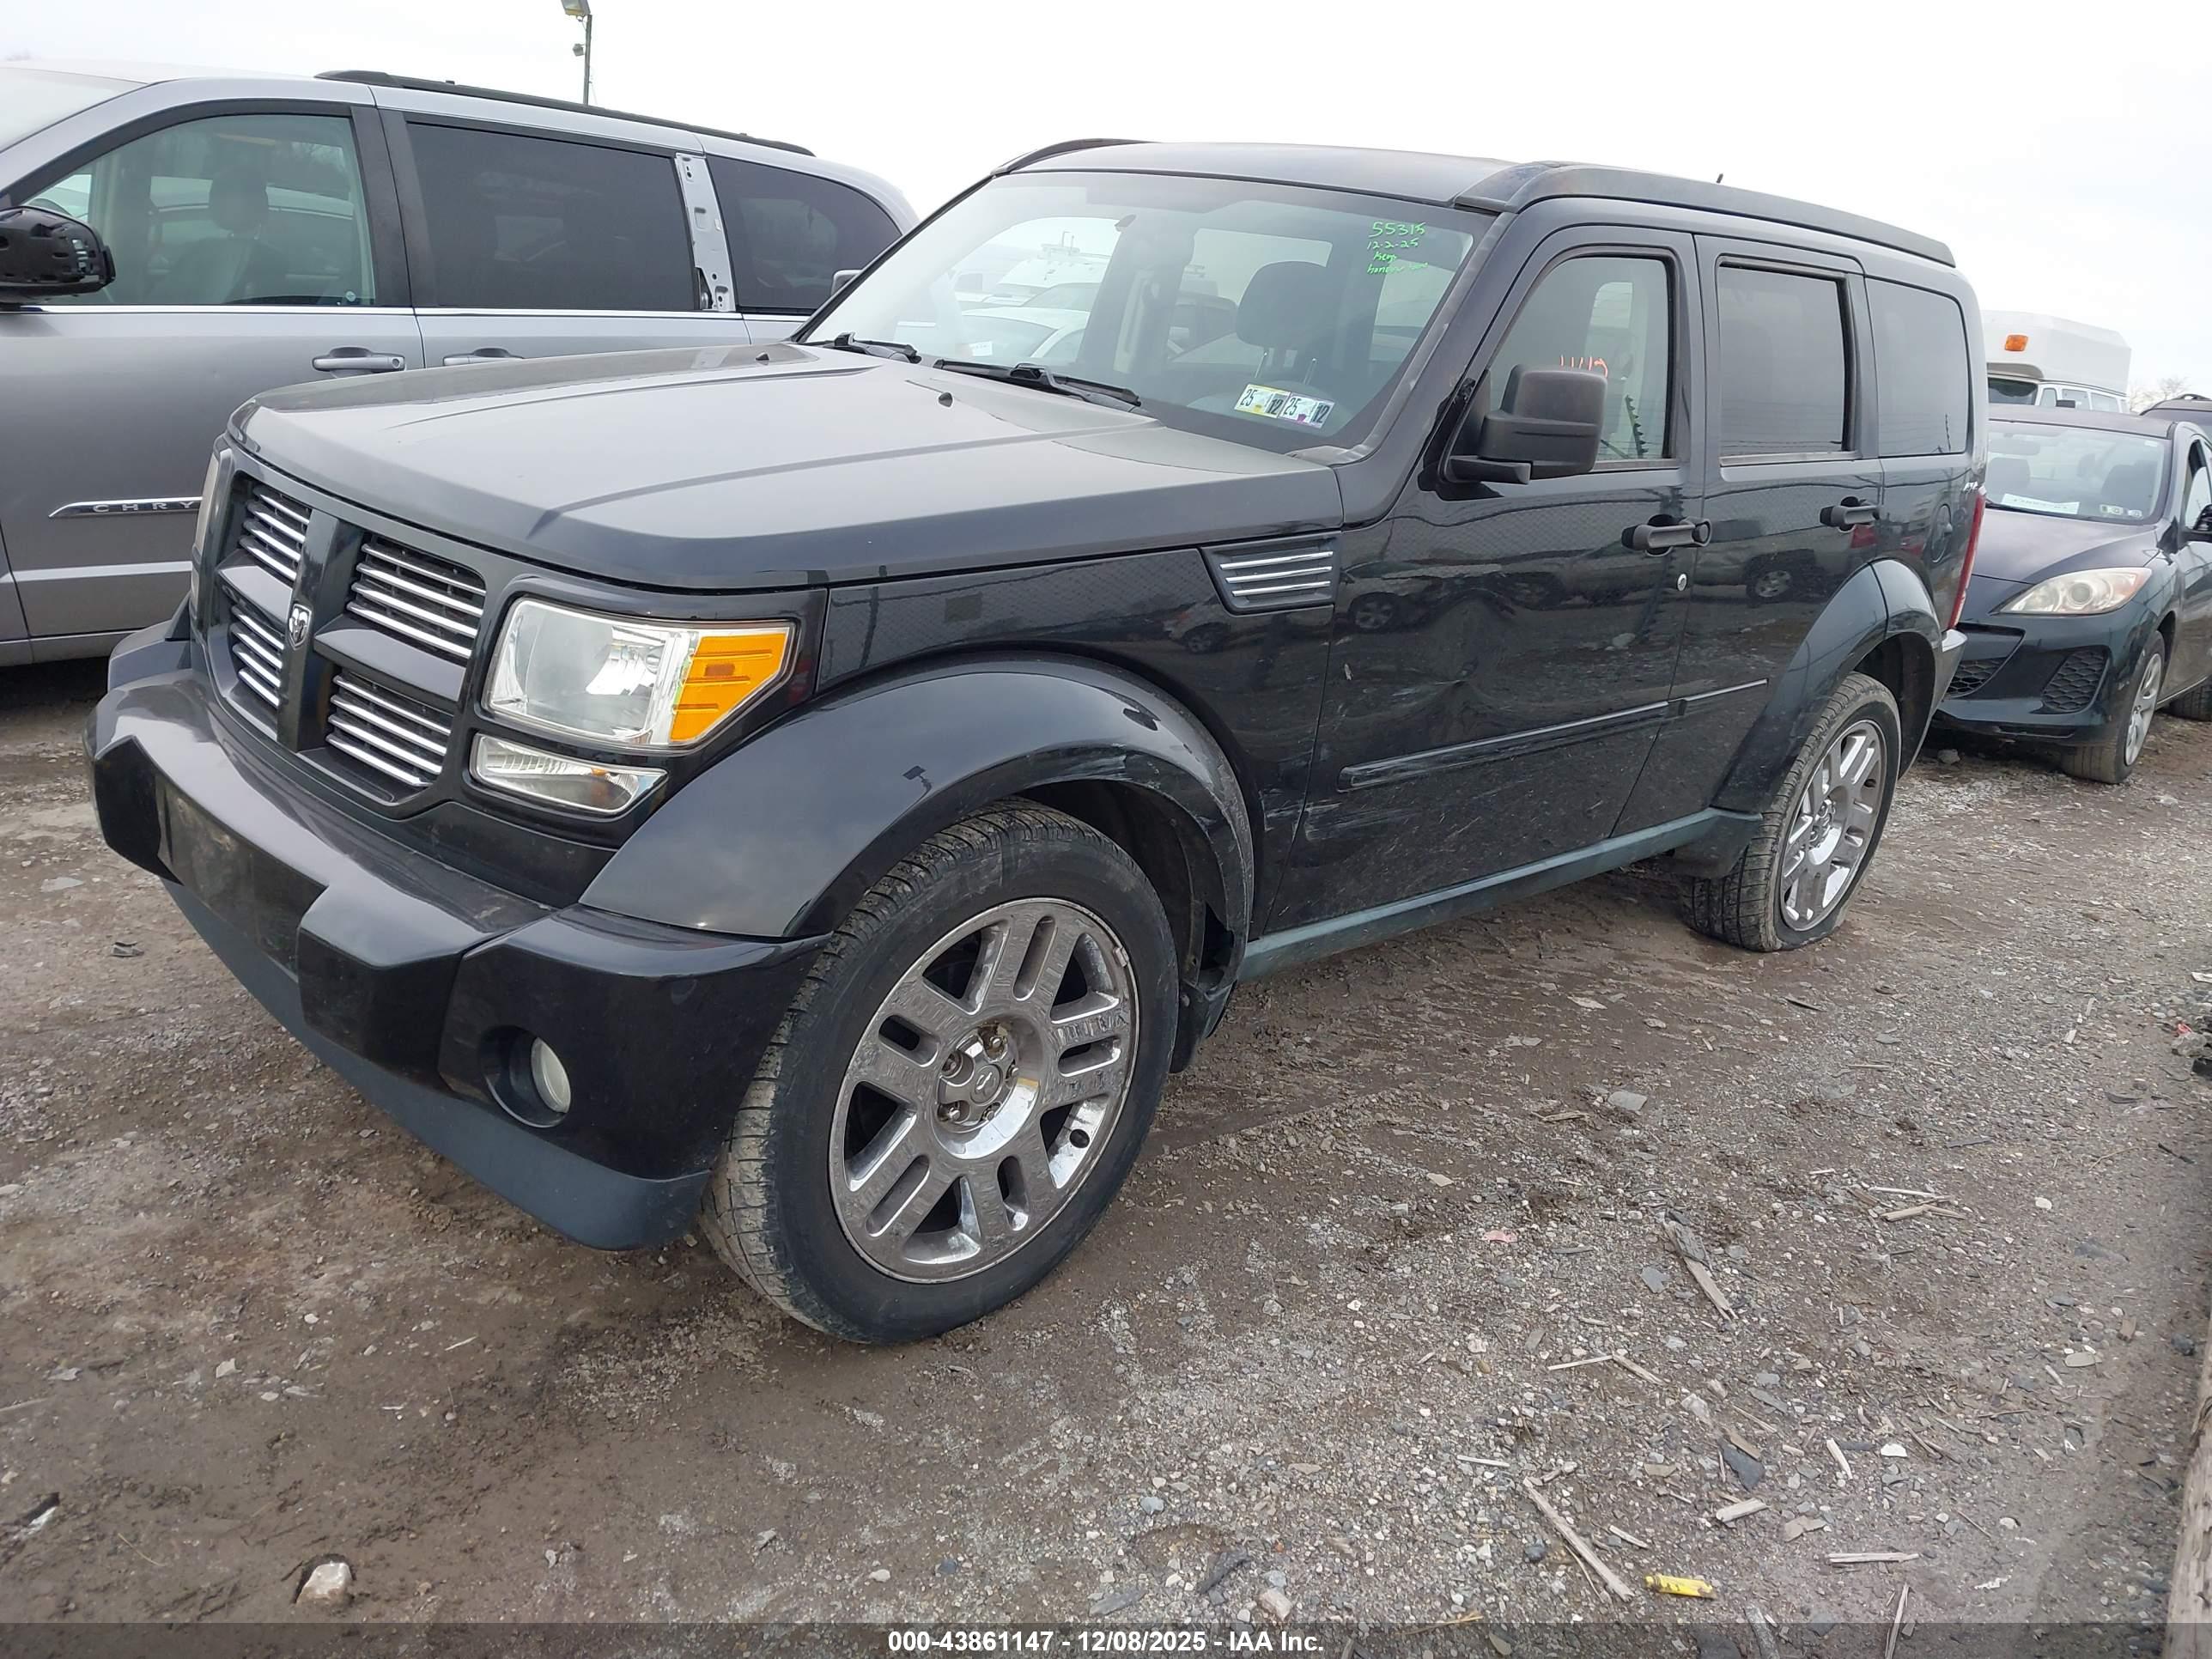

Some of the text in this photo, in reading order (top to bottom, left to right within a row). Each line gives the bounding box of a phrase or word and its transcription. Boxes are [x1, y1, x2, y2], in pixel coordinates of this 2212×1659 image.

[1240, 389, 1284, 415] 25 12
[1284, 398, 1330, 423] 25 12
